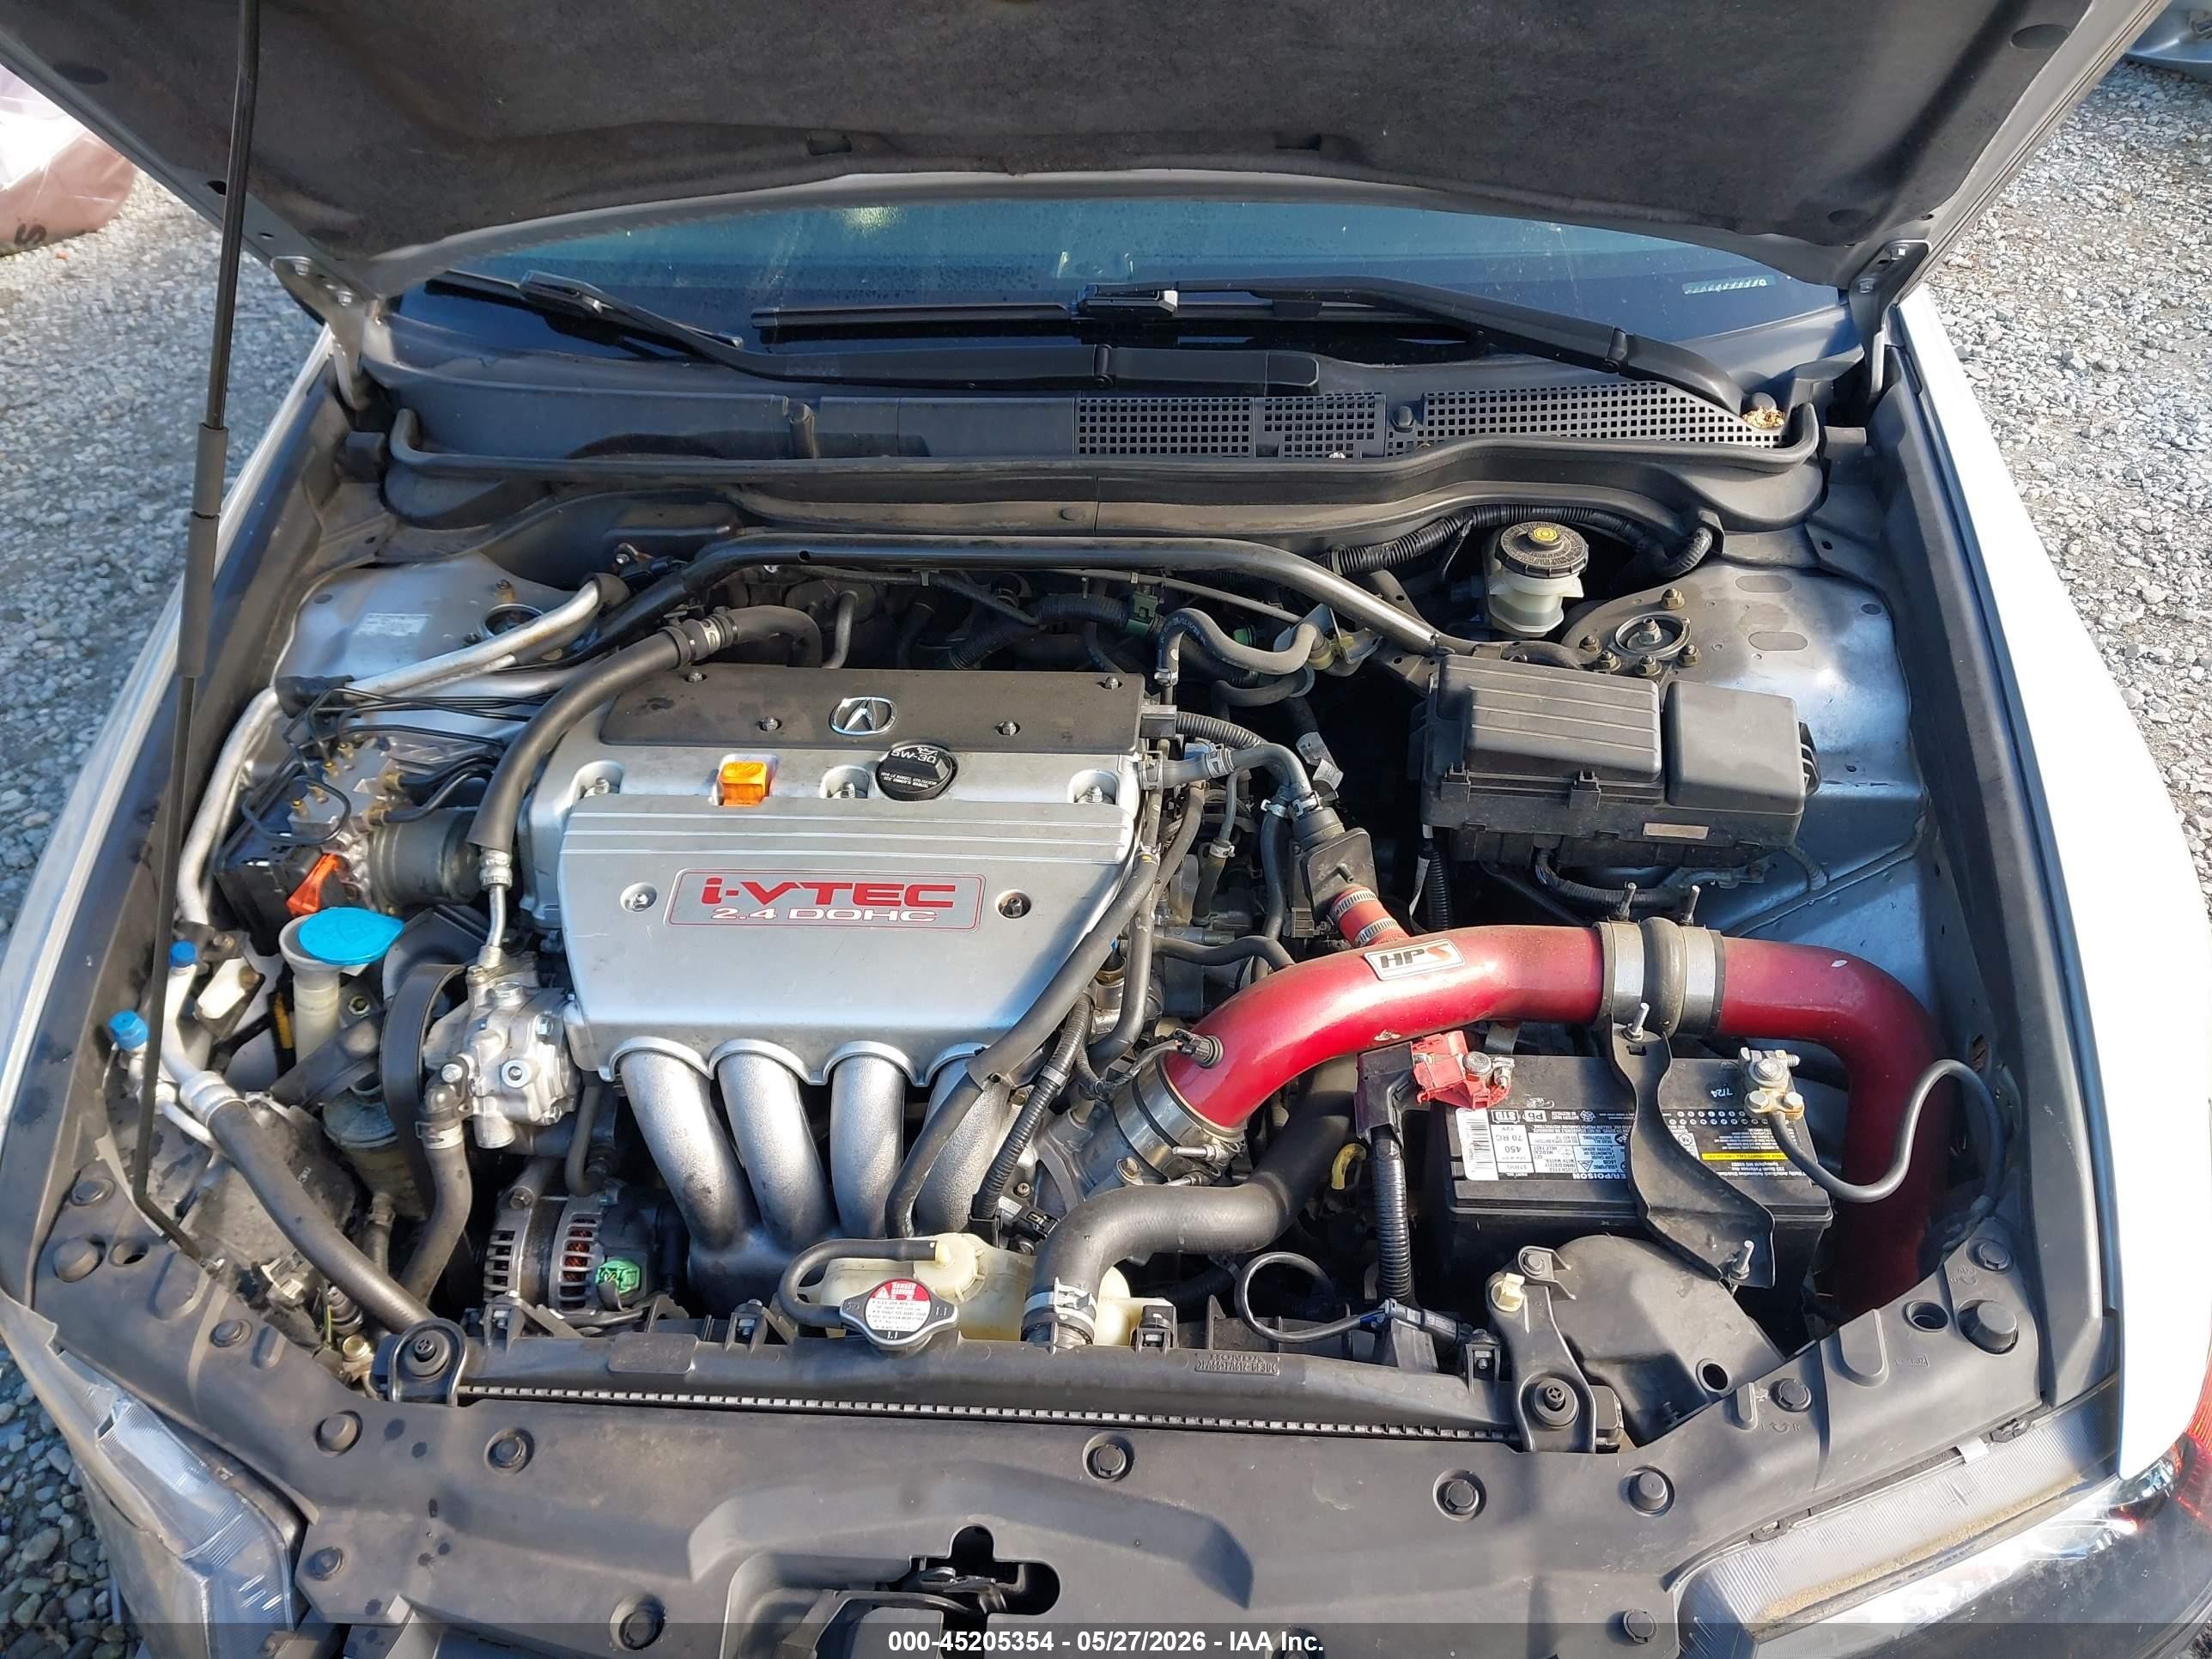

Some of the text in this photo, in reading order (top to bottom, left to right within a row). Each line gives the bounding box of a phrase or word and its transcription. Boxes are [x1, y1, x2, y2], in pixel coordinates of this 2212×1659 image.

[890, 748, 937, 764] 5W-30
[701, 877, 956, 908] i-VTEC
[711, 908, 938, 923] 2.4 DOHC
[1380, 943, 1451, 969] HPS
